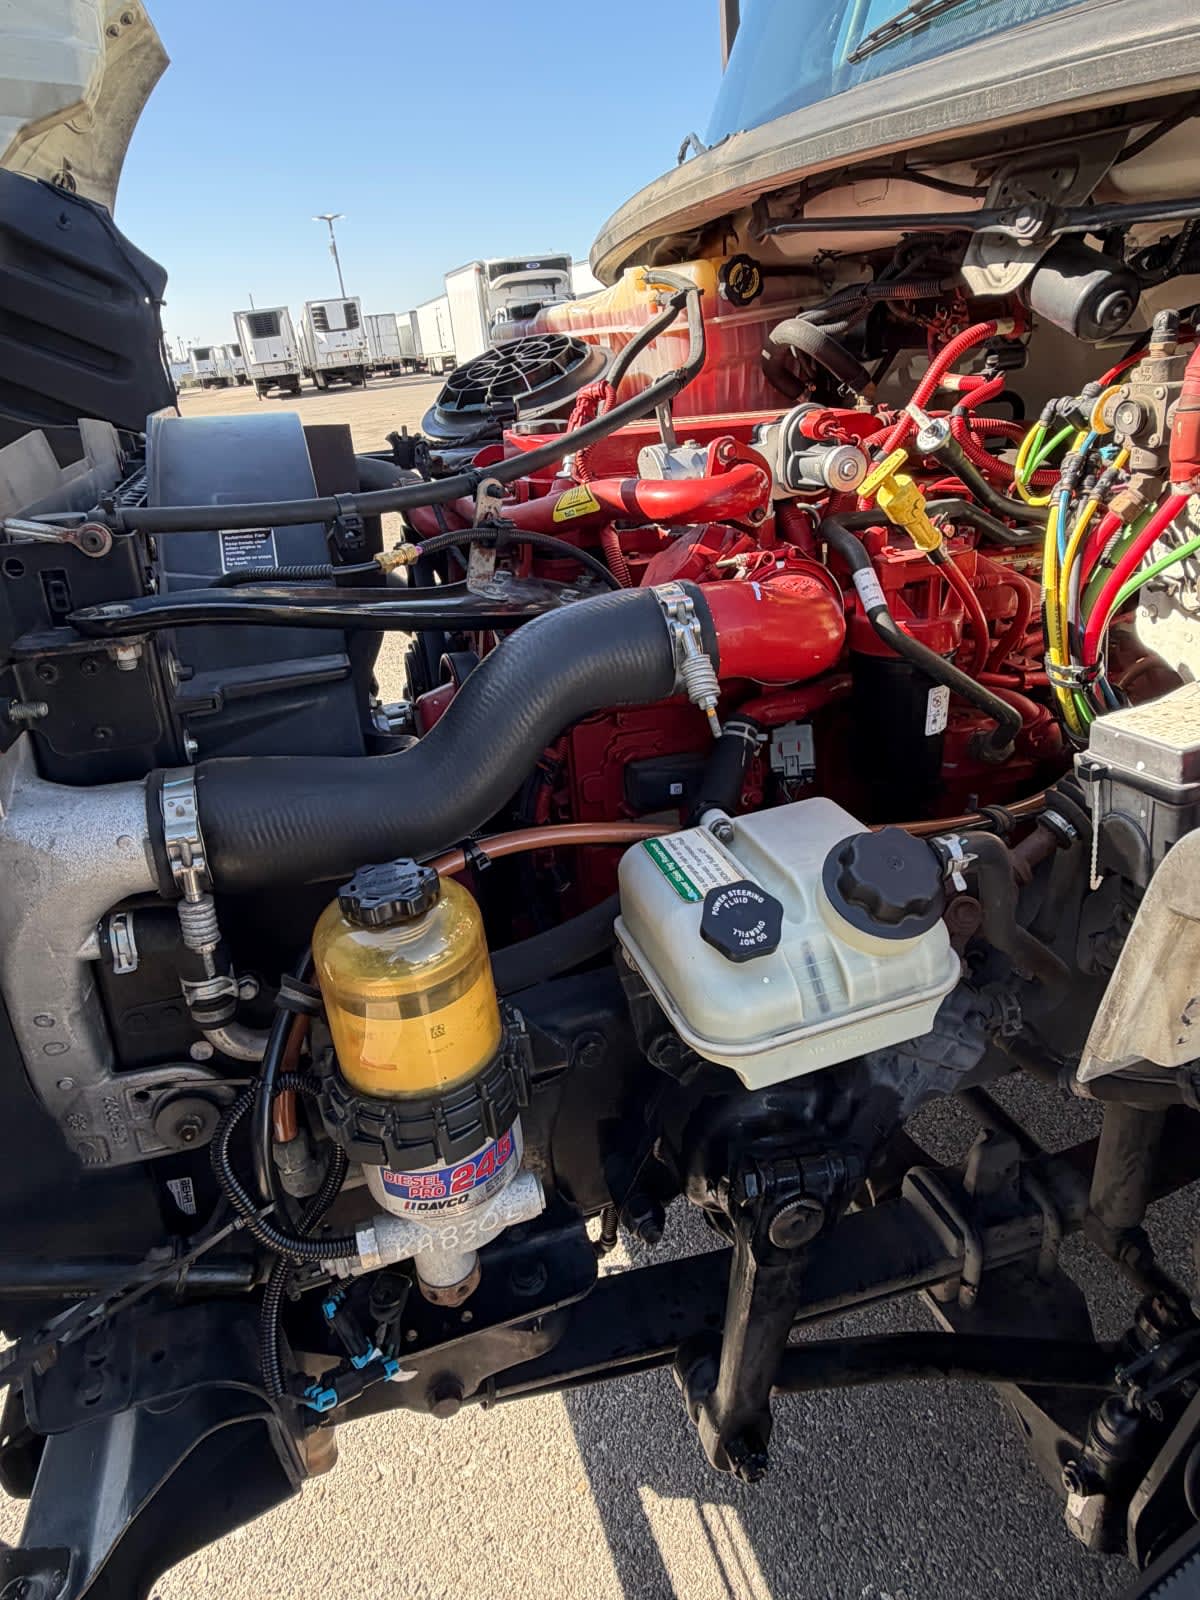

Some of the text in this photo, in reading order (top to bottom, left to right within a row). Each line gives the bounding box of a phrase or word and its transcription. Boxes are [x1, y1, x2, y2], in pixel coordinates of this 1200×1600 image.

[712, 890, 764, 916] POWER STEERING
[724, 897, 748, 909] FLUID
[733, 920, 765, 938] OVERFILL
[756, 933, 767, 942] DO
[450, 1130, 512, 1194] 245
[383, 1170, 444, 1187] DIESEL
[408, 1185, 446, 1198] PRO
[417, 1194, 468, 1210] DAVCO
